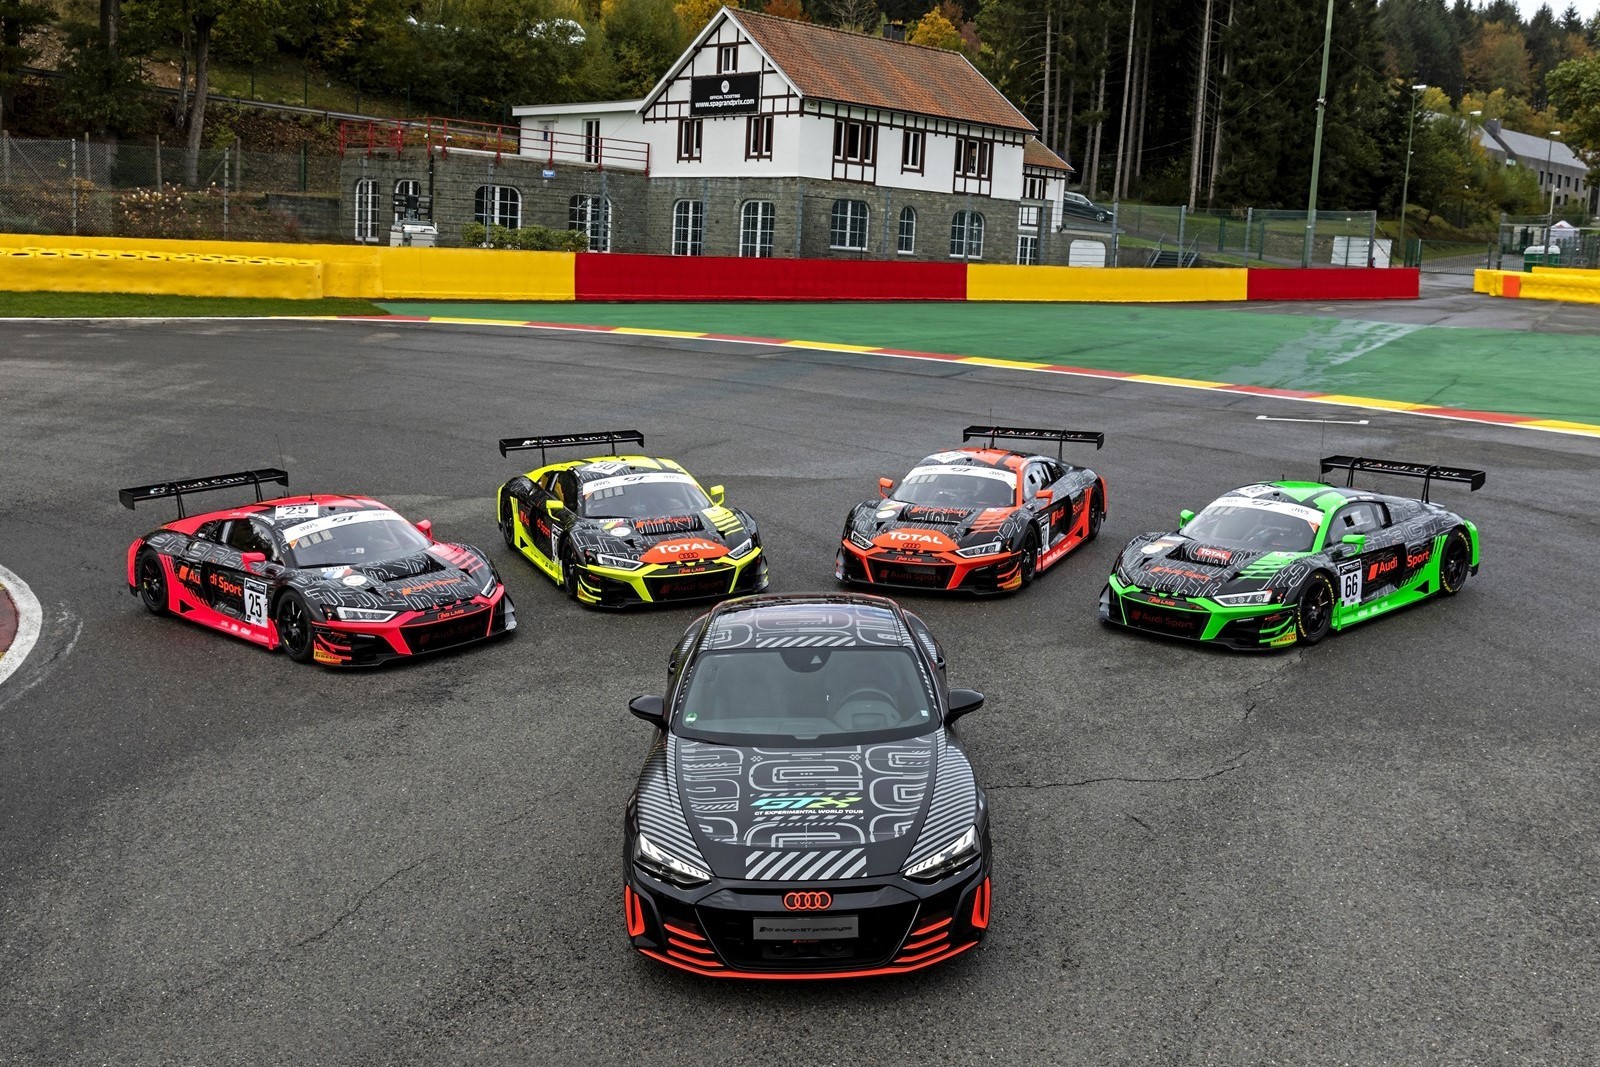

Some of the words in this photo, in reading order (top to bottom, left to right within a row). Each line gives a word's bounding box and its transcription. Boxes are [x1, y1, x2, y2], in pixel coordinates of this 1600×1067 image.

[695, 98, 755, 108] www.spagrandprix.com
[285, 505, 310, 516] 25
[888, 531, 943, 545] TOTAL
[655, 542, 716, 554] TOTAL
[1200, 548, 1227, 560] TOTAL
[1378, 555, 1398, 574] Audi
[1406, 550, 1430, 569] Sport
[218, 576, 243, 597] Sport
[1345, 573, 1358, 599] 66
[248, 592, 263, 618] 25
[1142, 611, 1162, 624] Audi
[1165, 615, 1195, 629] Sport
[750, 797, 863, 810] GTX
[812, 925, 853, 934] prototype
